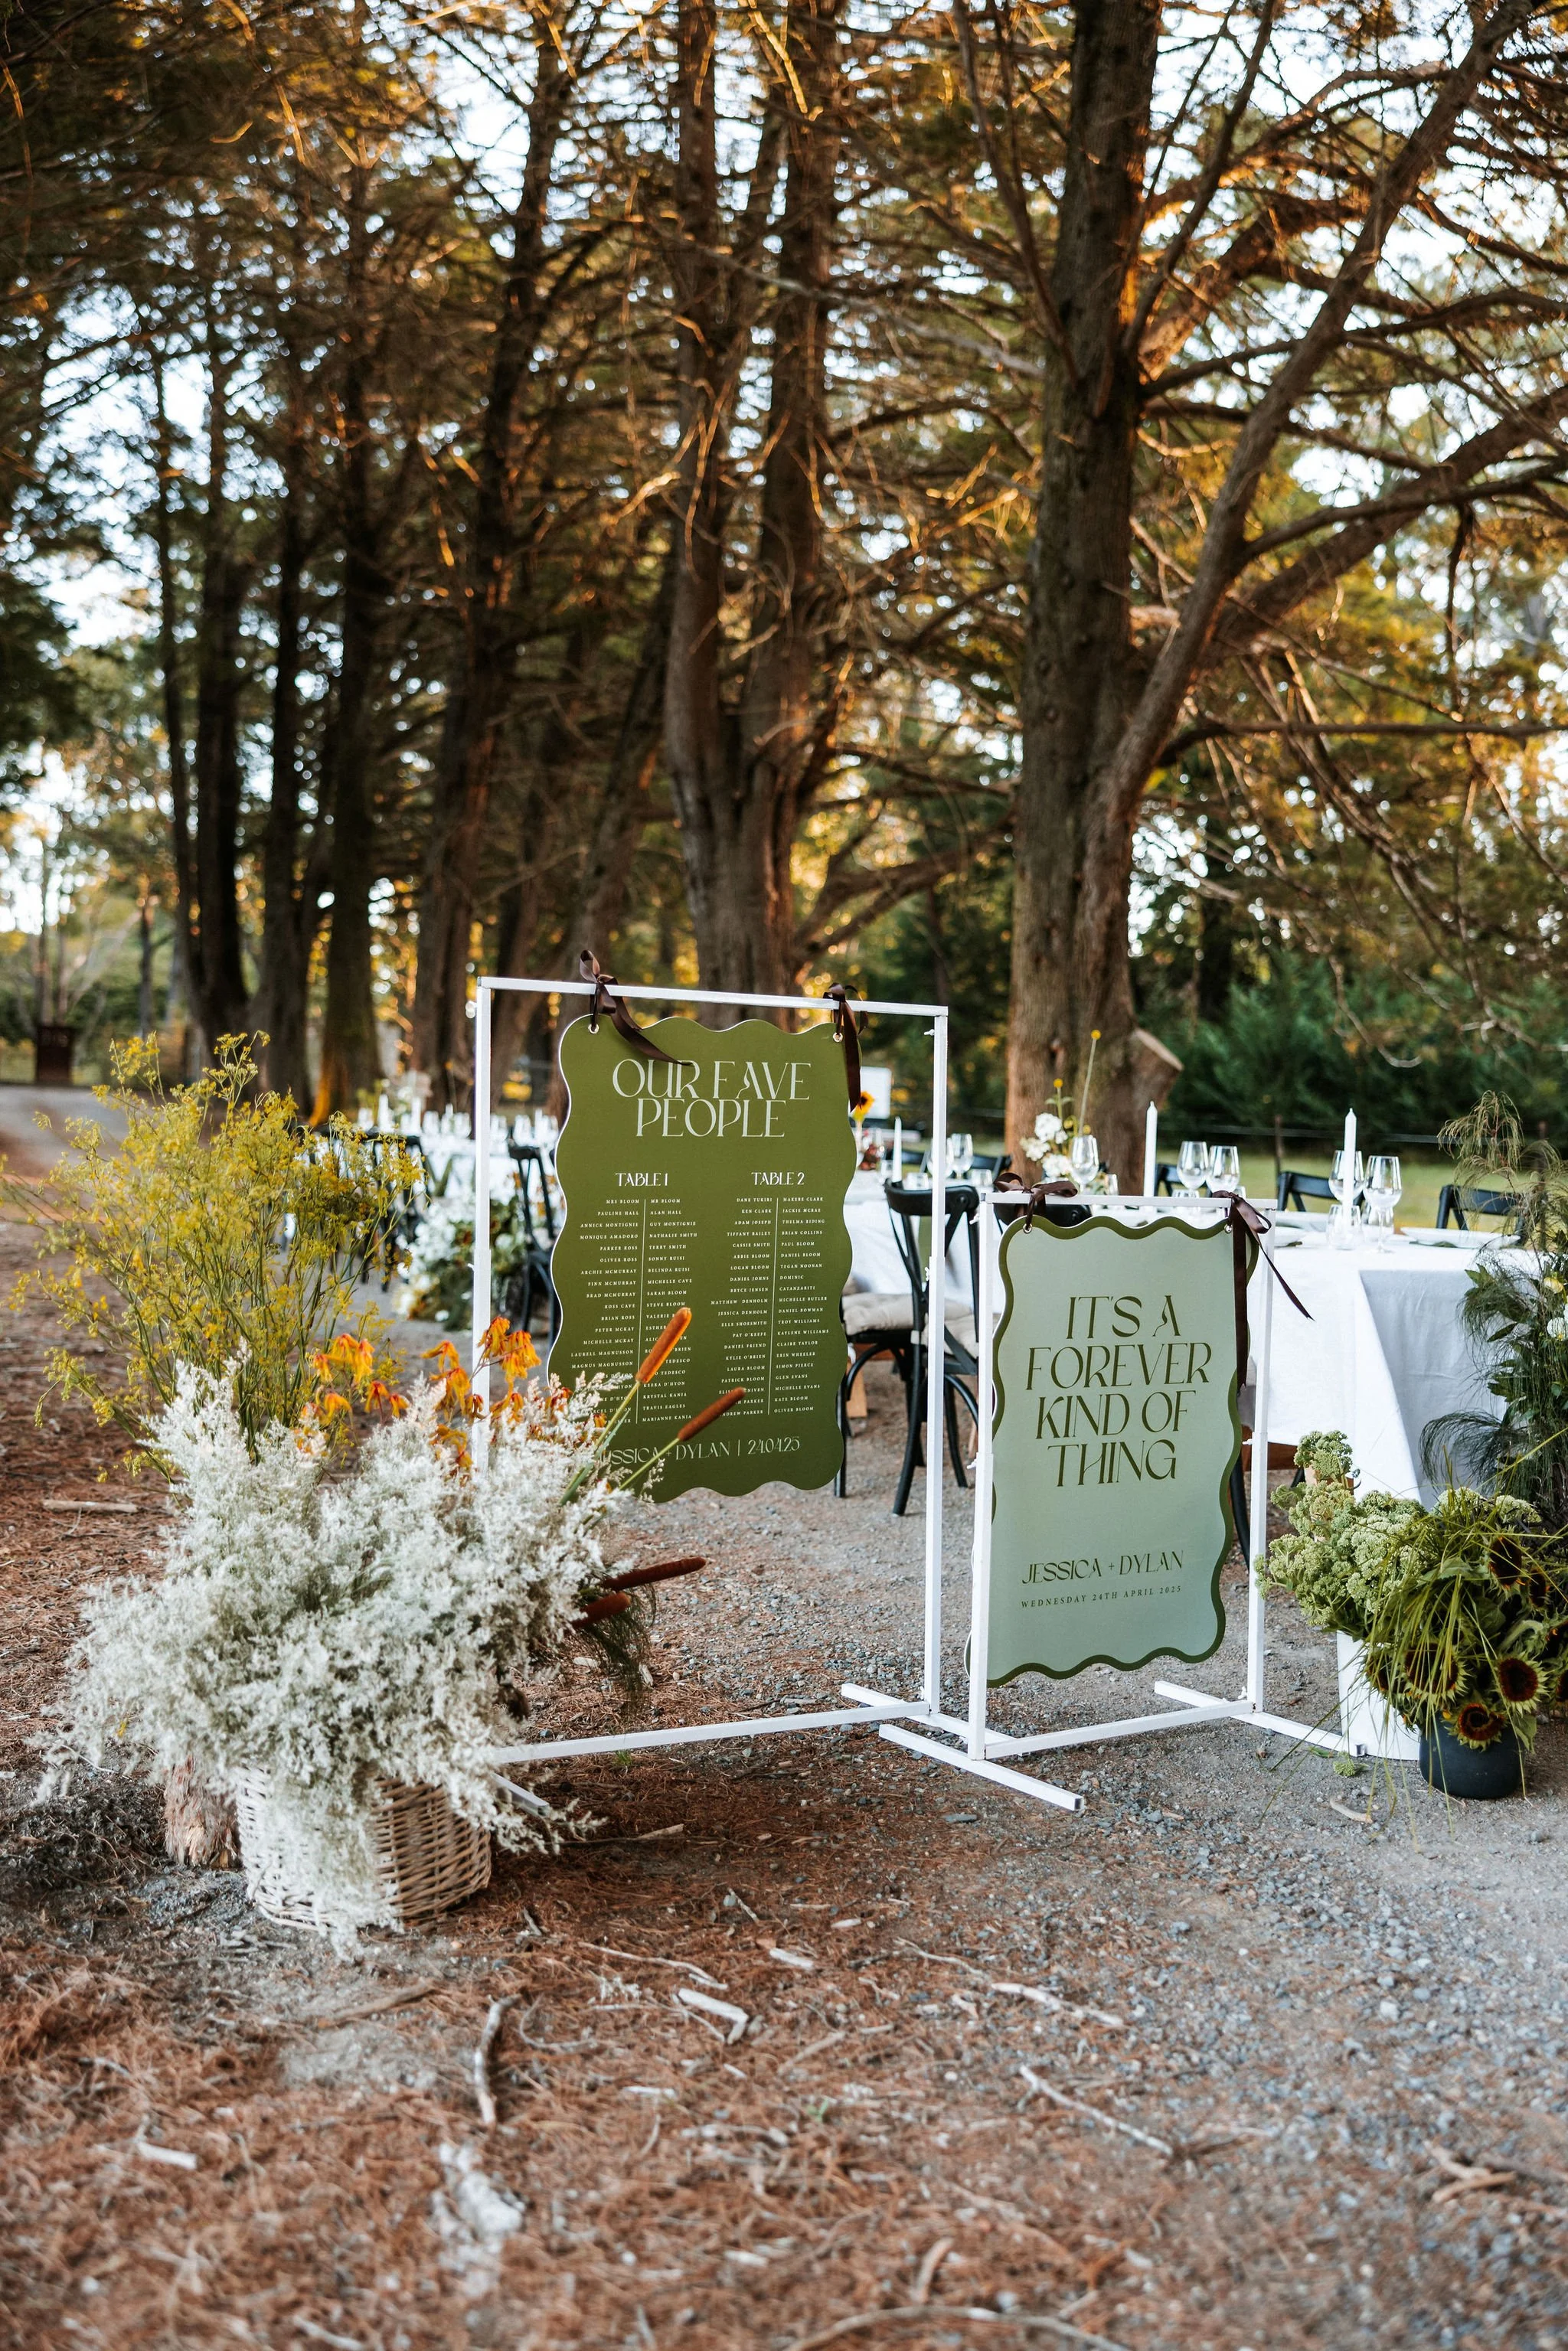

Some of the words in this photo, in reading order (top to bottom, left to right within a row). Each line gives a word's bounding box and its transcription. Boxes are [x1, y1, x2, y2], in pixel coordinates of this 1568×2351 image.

[612, 1059, 700, 1099] OUR
[713, 1061, 811, 1099] FAVE
[636, 1099, 786, 1137] PEOPLE
[616, 1173, 661, 1187] TABLE
[665, 1173, 668, 1186] 1
[752, 1172, 794, 1185] TABLE
[797, 1172, 805, 1185] 2
[1067, 1296, 1142, 1339] IT'S
[1152, 1295, 1181, 1337] A
[1026, 1343, 1211, 1390] FOREVER
[1036, 1393, 1130, 1439] KIND
[1142, 1390, 1196, 1432] OF
[676, 1442, 730, 1461] DYLAN
[1048, 1439, 1176, 1487] THING
[1022, 1558, 1102, 1584] JESSICA
[1119, 1550, 1184, 1575] DYLAN
[1021, 1595, 1087, 1608] WEDNESDAY
[1093, 1592, 1117, 1601] 24TH
[1123, 1589, 1154, 1598] APRIL
[1160, 1585, 1181, 1594] 2025
